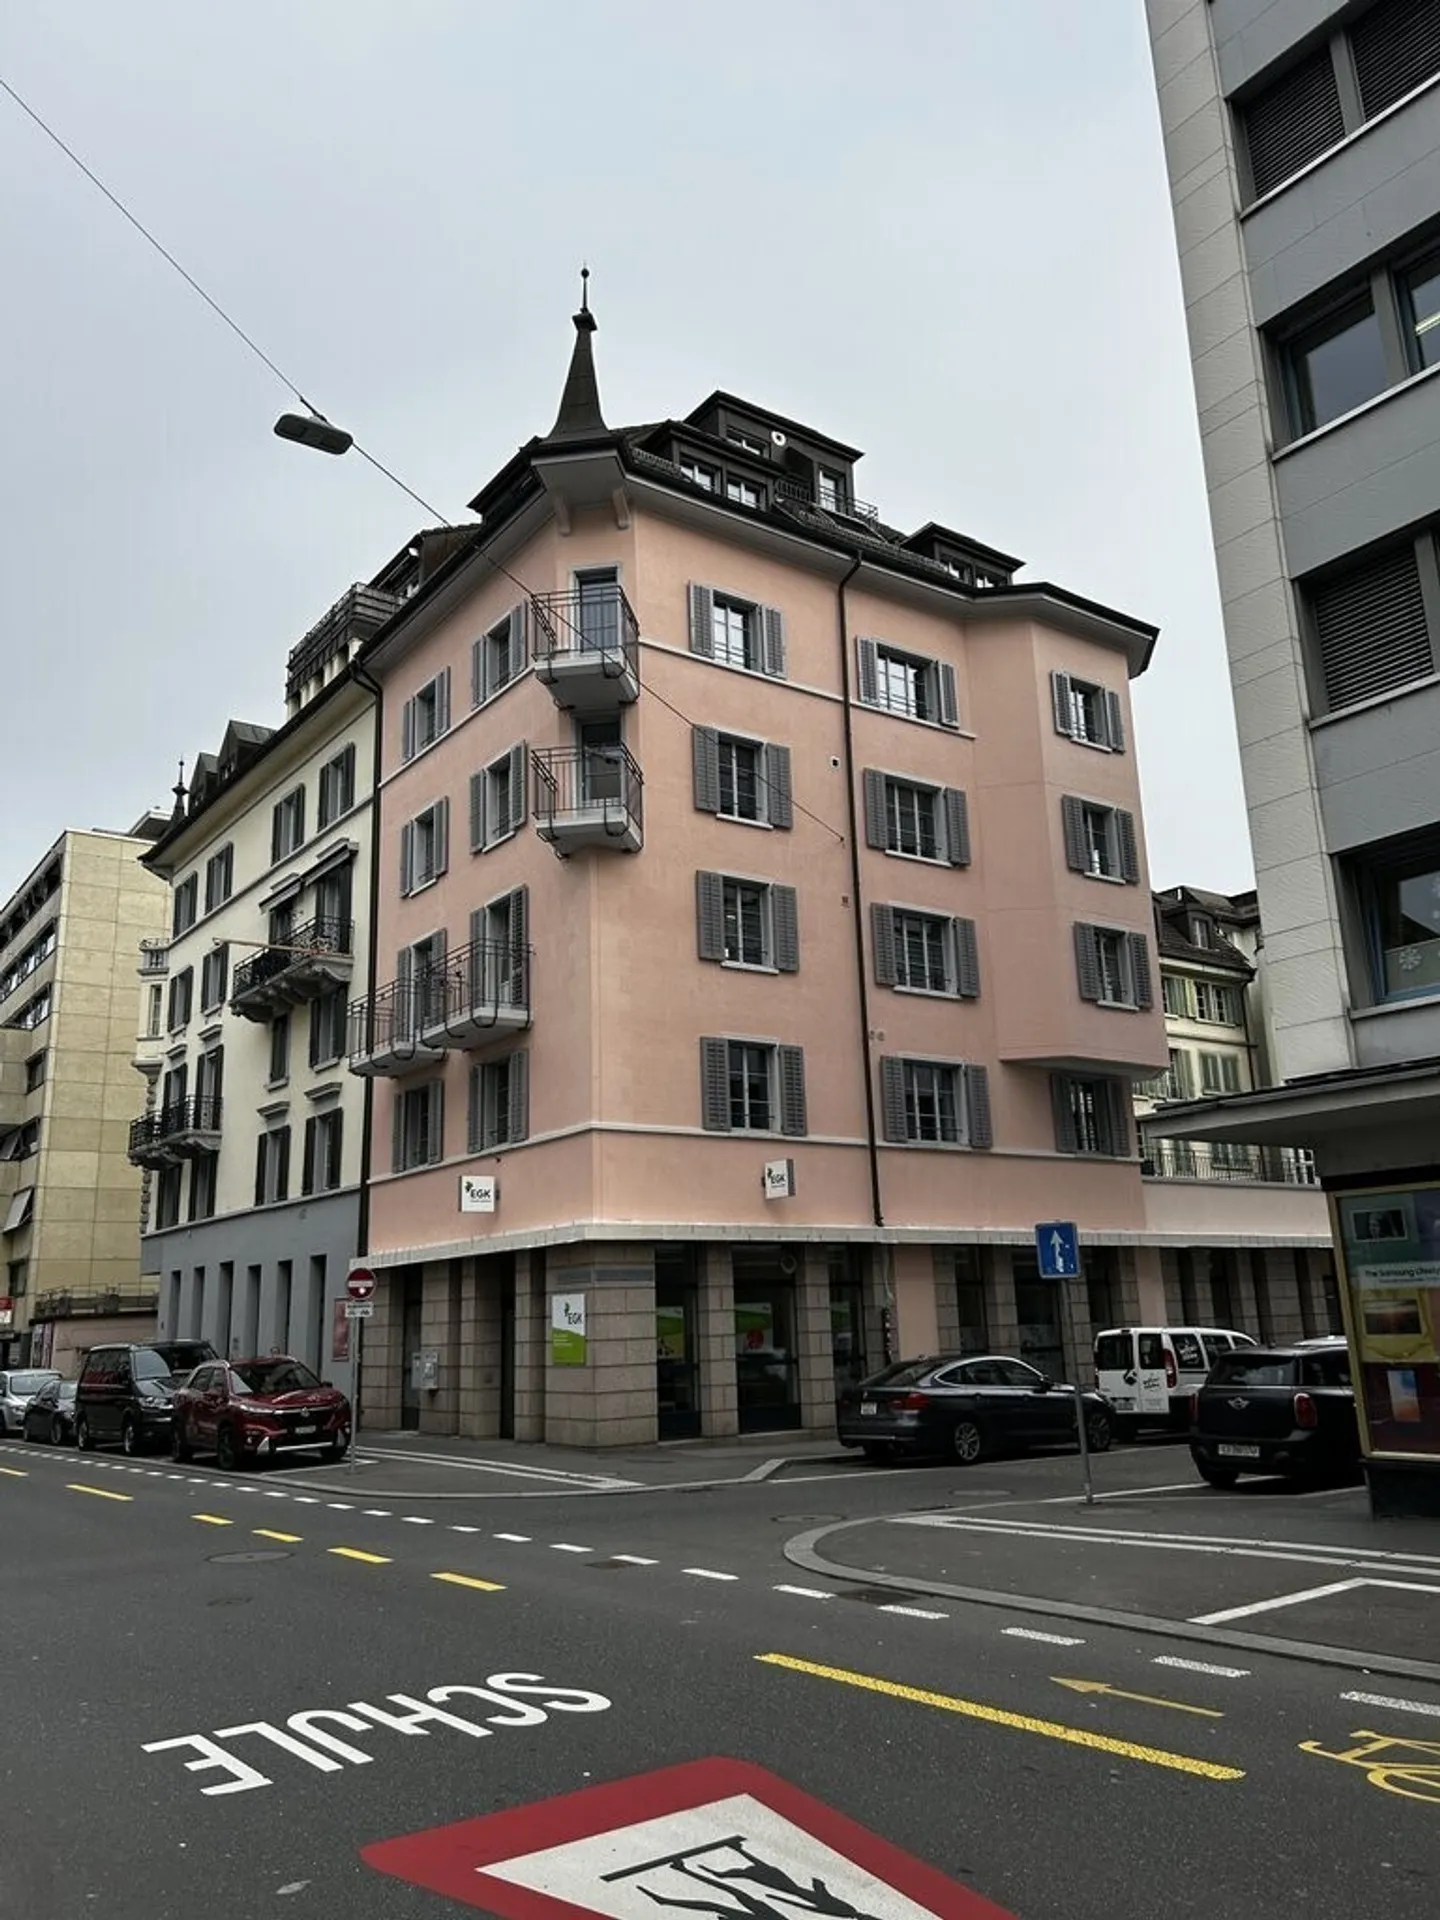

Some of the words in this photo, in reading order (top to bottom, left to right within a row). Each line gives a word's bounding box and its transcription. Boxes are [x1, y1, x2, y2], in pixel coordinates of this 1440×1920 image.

[470, 1189, 491, 1199] EGK
[568, 1312, 583, 1325] EGK
[141, 1672, 612, 1796] SCHULE
